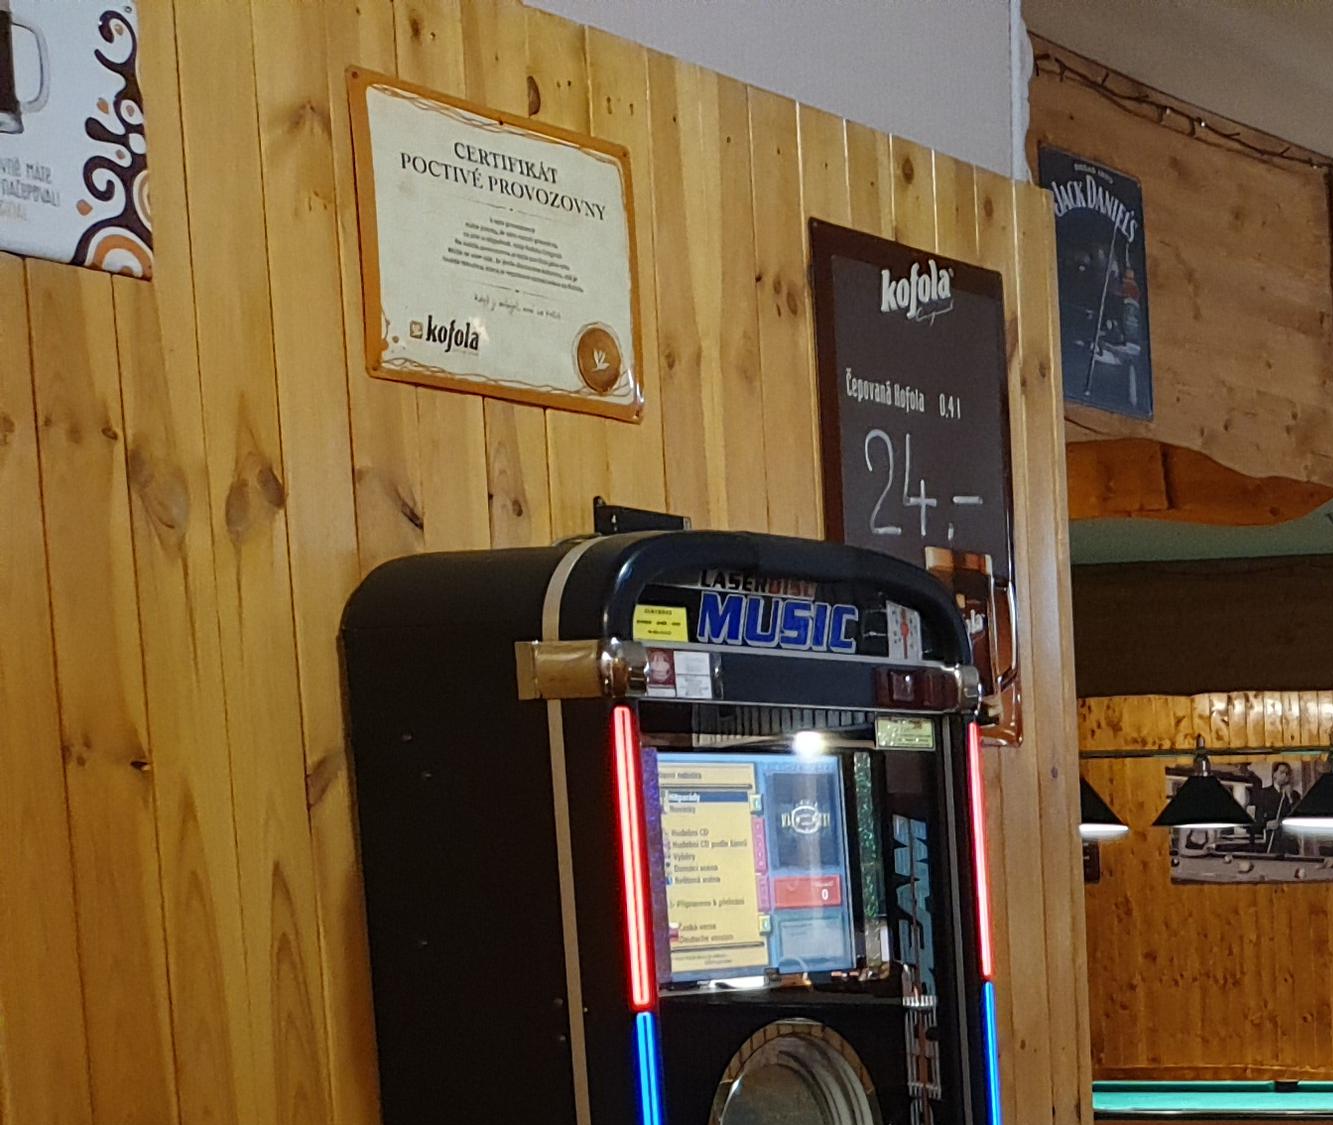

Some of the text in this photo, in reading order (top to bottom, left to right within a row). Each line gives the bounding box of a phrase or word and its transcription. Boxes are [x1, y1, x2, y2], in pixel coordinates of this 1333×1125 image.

[453, 141, 559, 185] CERTIFIKÁT
[400, 151, 607, 222] POCTIVÉ PROVOZOVNY
[1051, 180, 1087, 217] JACK
[880, 258, 955, 319] kofola
[425, 314, 480, 353] kofola
[845, 367, 893, 406] Čepovaná
[697, 591, 859, 654] MUSIC
